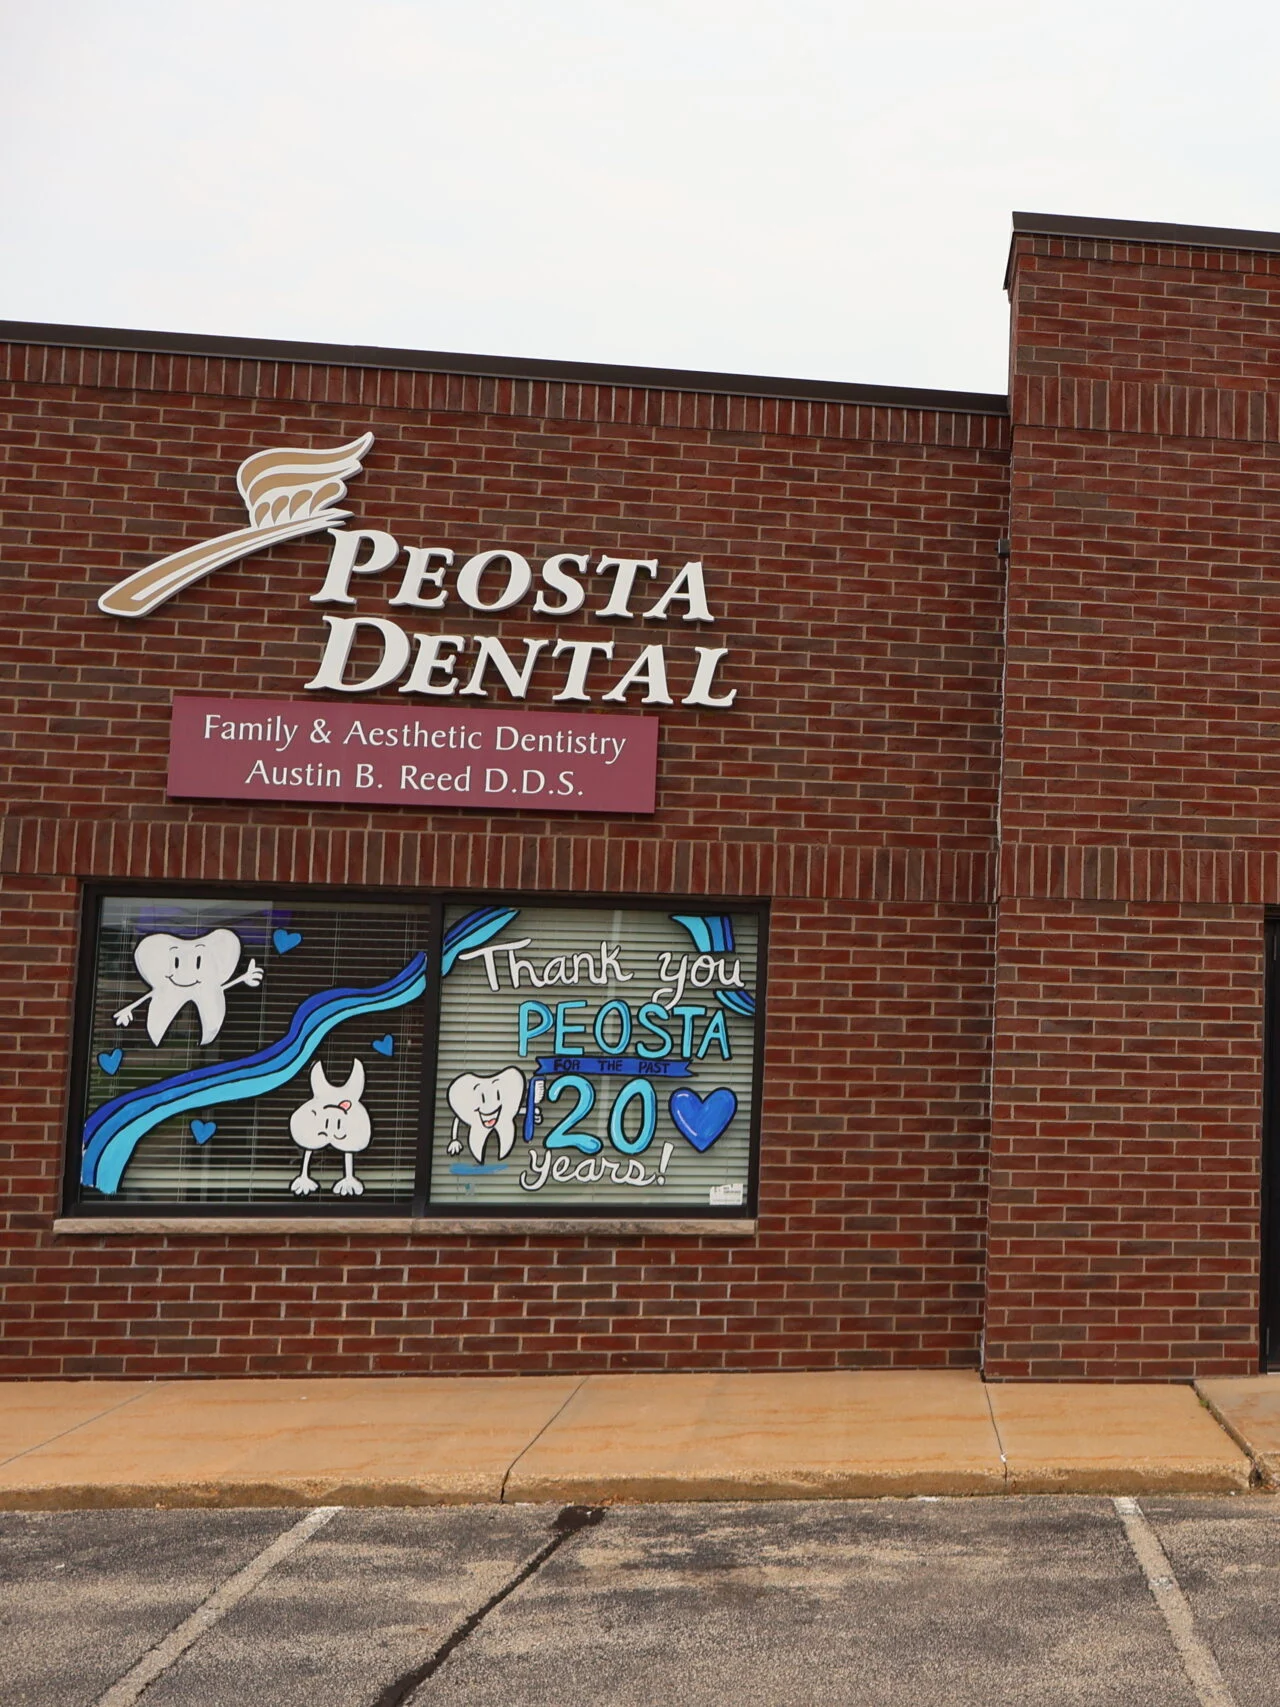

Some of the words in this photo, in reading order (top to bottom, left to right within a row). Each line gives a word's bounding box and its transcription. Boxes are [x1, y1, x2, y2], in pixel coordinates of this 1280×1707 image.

[309, 528, 715, 623] PEOSTA
[303, 615, 738, 708] DENTAL
[203, 714, 299, 752] Family
[310, 719, 331, 745] &
[345, 719, 483, 752] Aesthetic
[495, 726, 628, 765] Dentistry
[244, 759, 342, 790] Austin
[355, 765, 383, 790] B.
[401, 766, 472, 794] Reed
[485, 768, 584, 797] D.D.S.
[458, 937, 635, 991] Thank
[652, 951, 745, 1010] you
[517, 999, 732, 1061] PEOSTA
[553, 1059, 581, 1071] FOR
[598, 1060, 623, 1072] THE
[638, 1061, 670, 1074] PAST
[542, 1073, 658, 1155] 20
[519, 1141, 674, 1191] years!
